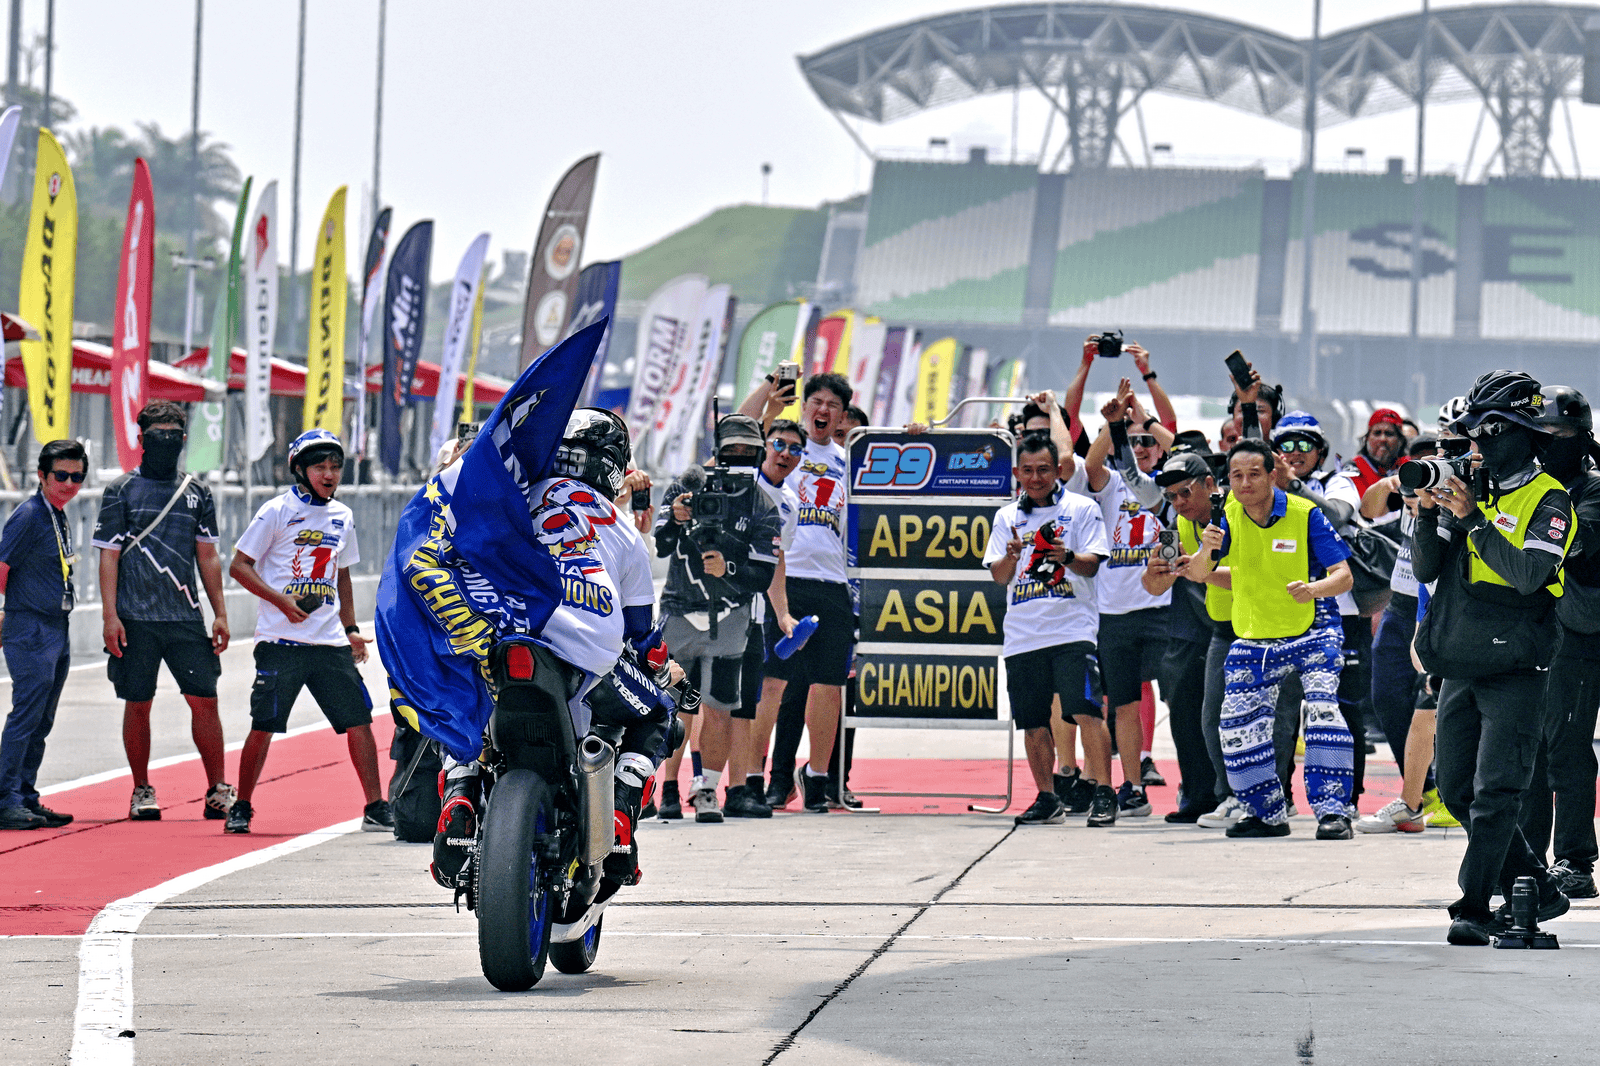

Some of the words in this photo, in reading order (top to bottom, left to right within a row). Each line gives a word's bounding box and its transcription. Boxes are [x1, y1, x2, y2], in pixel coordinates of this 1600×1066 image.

[42, 214, 57, 428] DUNLOP
[858, 445, 934, 487] 39
[948, 453, 989, 469] IDEA
[869, 514, 991, 558] AP250
[309, 546, 332, 583] 1
[875, 588, 996, 634] ASIA
[859, 662, 995, 709] CHAMPION
